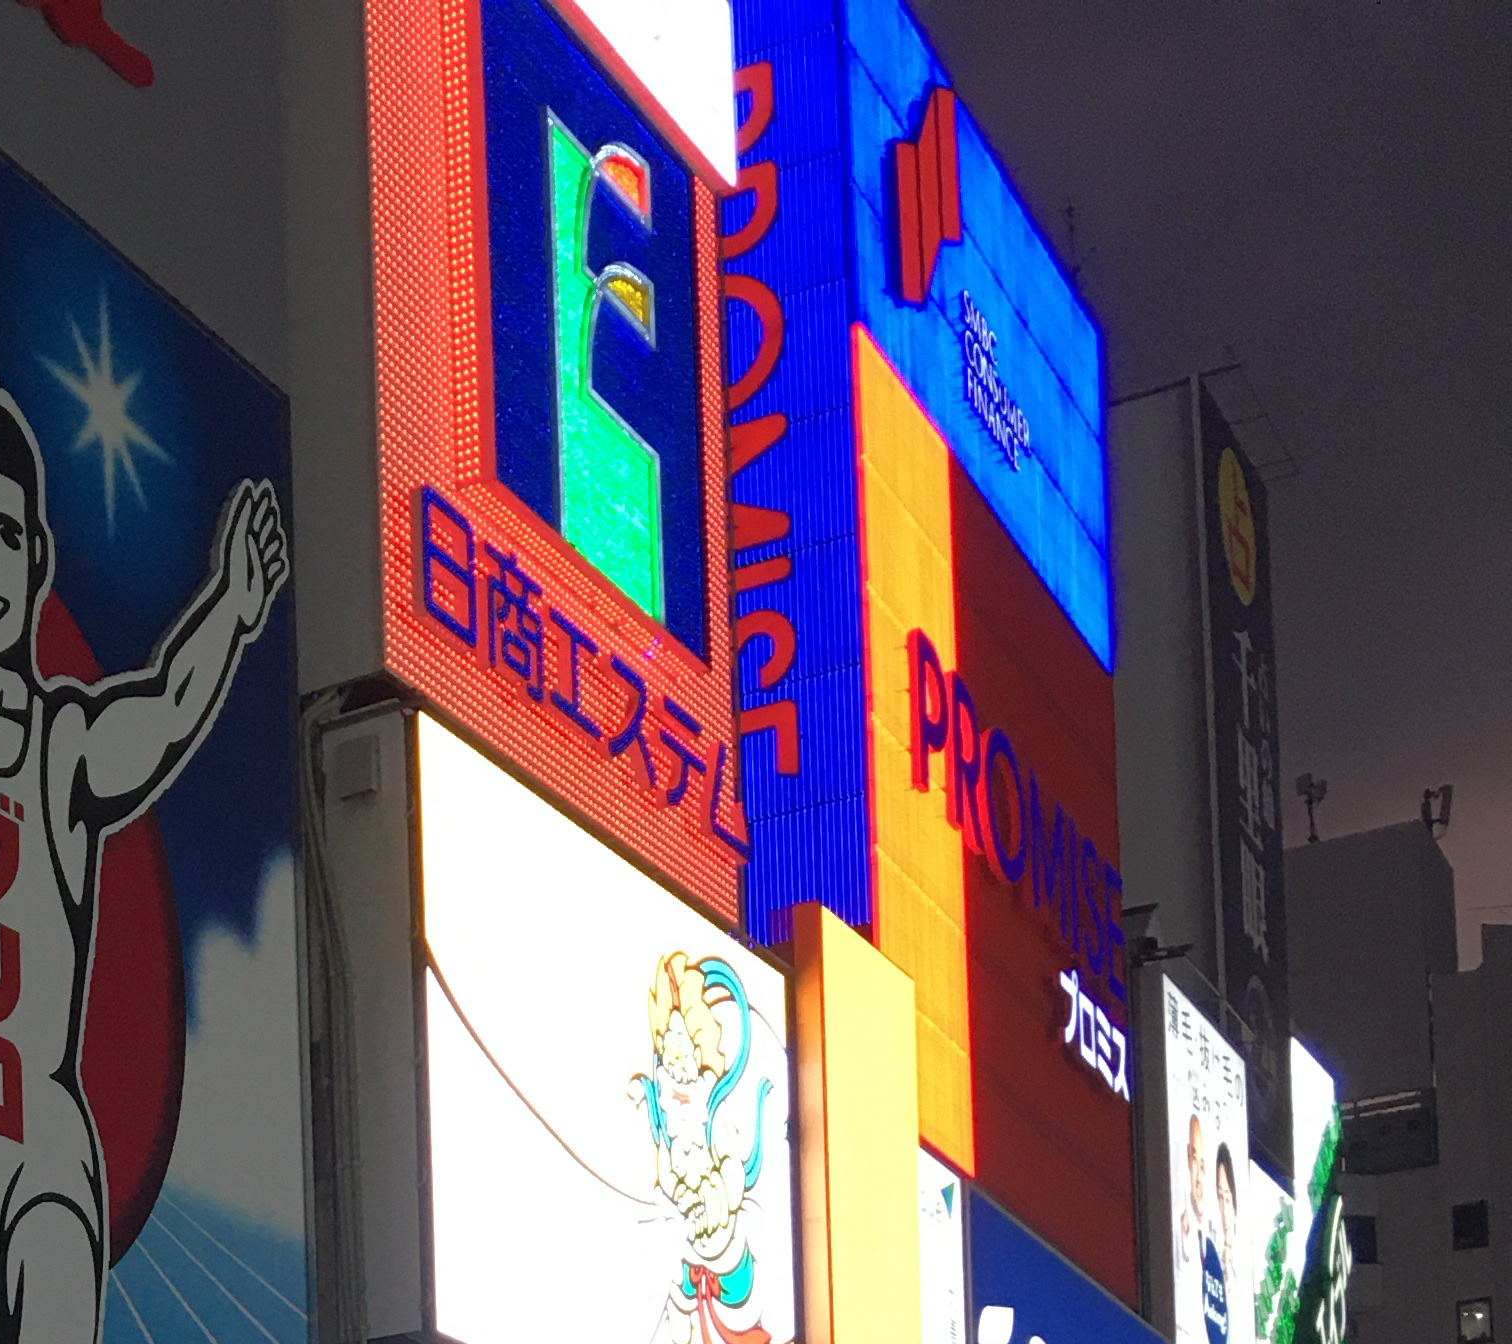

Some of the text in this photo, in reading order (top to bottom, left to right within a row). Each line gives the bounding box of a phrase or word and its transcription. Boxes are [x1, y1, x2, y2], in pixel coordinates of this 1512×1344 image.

[964, 290, 998, 367] SMBC
[965, 330, 1031, 455] CONSUMER
[967, 366, 1020, 471] FINANCE
[908, 627, 1126, 1001] PROMISE
[1059, 968, 1131, 1103] プロミス
